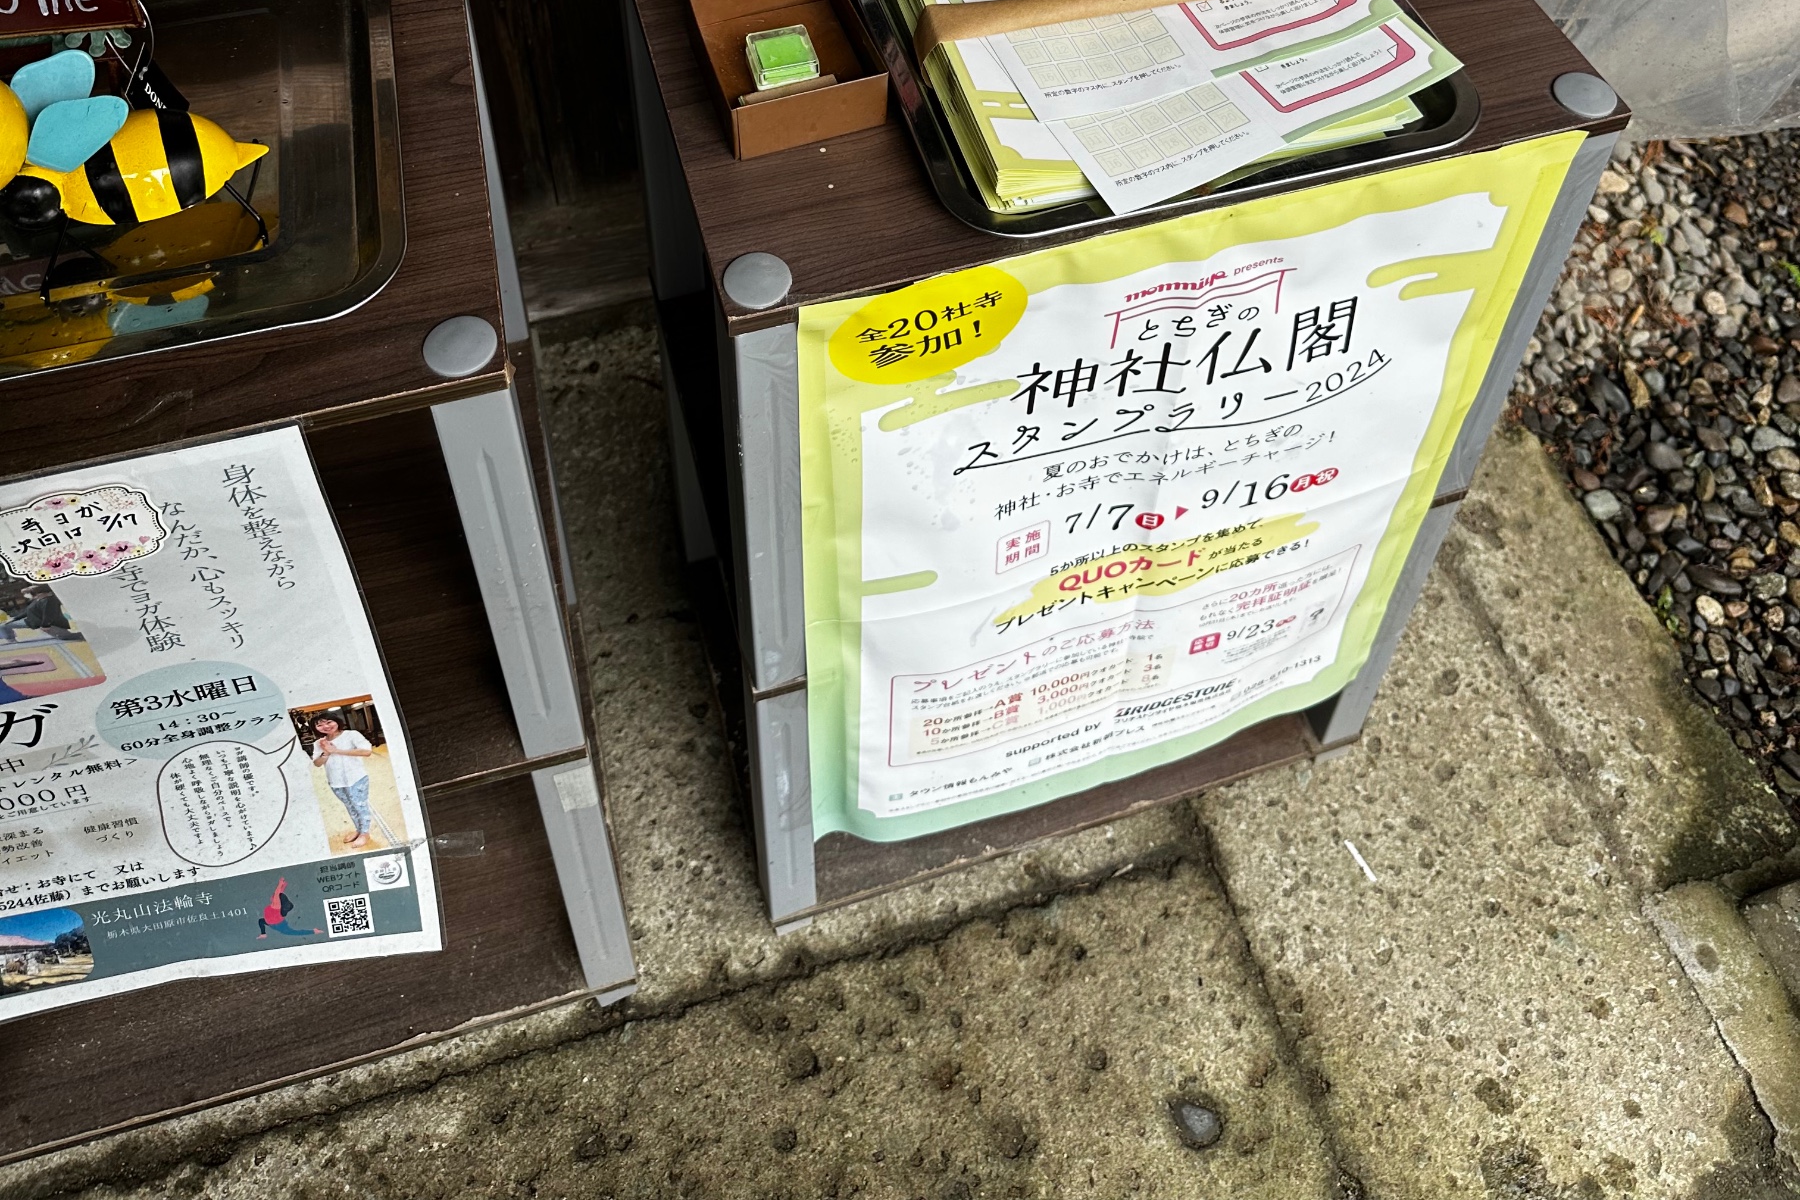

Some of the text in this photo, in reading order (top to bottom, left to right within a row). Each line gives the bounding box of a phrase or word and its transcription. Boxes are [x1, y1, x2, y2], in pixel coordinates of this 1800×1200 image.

[144, 82, 168, 110] DON
[1233, 256, 1284, 277] presents
[856, 291, 1003, 343] 全20社寺
[1138, 304, 1260, 341] とちぎの
[869, 320, 982, 369] 参加！
[1010, 296, 1359, 415] 神社仏閣
[953, 349, 1388, 476] スタンプラリー2024
[1042, 422, 1304, 483] 夏のおでかけは、とちぎの
[1065, 468, 1337, 535] 7/7 日 9/16 月祝
[11, 527, 82, 554] 次回は
[222, 464, 296, 591] 身体を整えながら
[1004, 530, 1041, 549] 実施
[1004, 544, 1041, 566] 期間
[1058, 537, 1264, 592] QUOカード が当たる
[161, 502, 244, 650] なんだか、心もスッキリ
[108, 564, 186, 653] 寺でヨガ体験
[1227, 618, 1275, 641] 9/23
[914, 619, 1155, 692] プレゼントのご応募方法
[110, 675, 257, 720] 第3水曜日
[1114, 677, 1238, 718] BRIDGESTONE
[121, 713, 284, 751] 60分全身調整クラス
[1005, 729, 1080, 758] supported
[1084, 721, 1102, 736] by
[0, 826, 44, 842] 深まる
[84, 817, 139, 834] 健康習慣
[96, 830, 134, 843] づくり
[0, 839, 44, 855] 勢改善
[82, 866, 201, 896] までお願いします
[114, 861, 145, 876] 又は
[316, 870, 361, 884] WEBサイト
[322, 881, 360, 893] QRコード
[90, 891, 213, 927] 光丸山法輪寺
